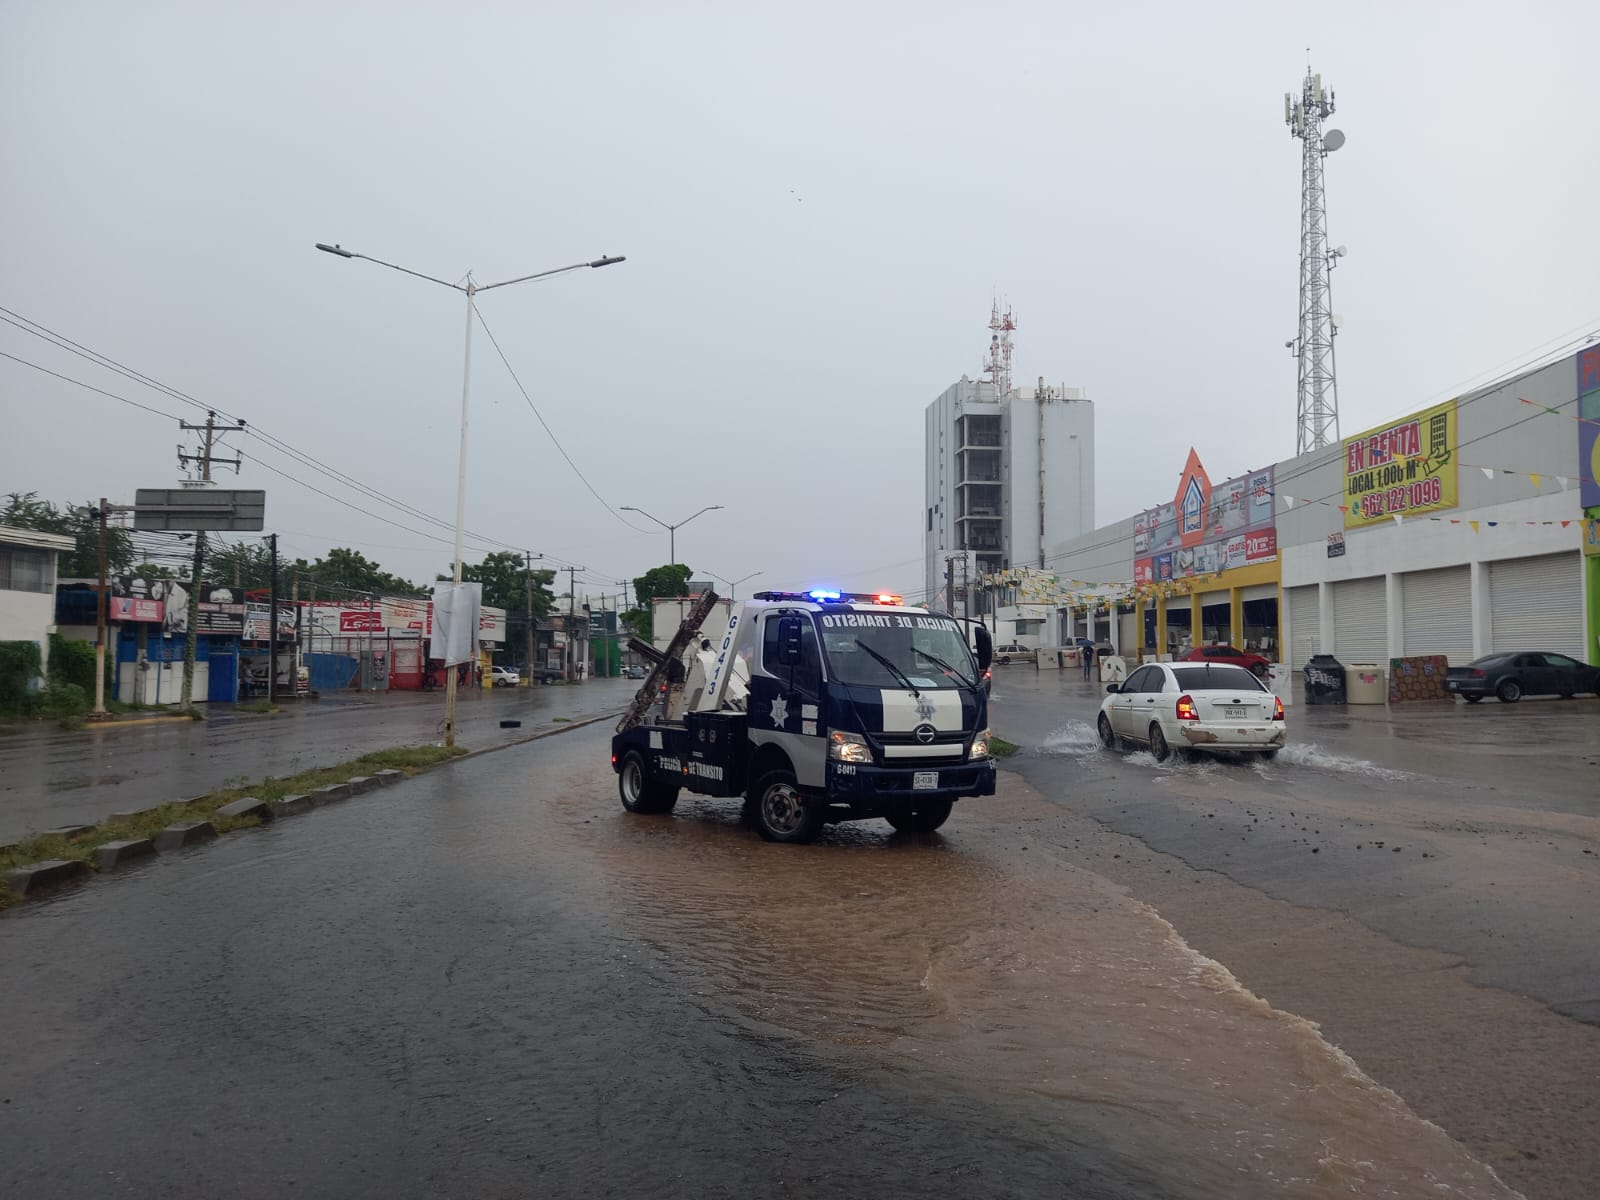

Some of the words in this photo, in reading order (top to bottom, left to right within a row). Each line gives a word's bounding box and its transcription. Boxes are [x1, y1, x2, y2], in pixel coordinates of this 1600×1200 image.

[1347, 440, 1365, 475] EN
[1368, 421, 1421, 470] RENTA
[1348, 472, 1375, 495] LOCAL
[1377, 464, 1404, 488] 1,000
[1362, 490, 1384, 519] 662
[1386, 485, 1406, 513] 122
[1408, 477, 1441, 508] 1096
[1246, 538, 1258, 555] 20
[687, 761, 696, 775] DE
[696, 761, 724, 781] TRANSITO
[836, 765, 857, 776] G-0413
